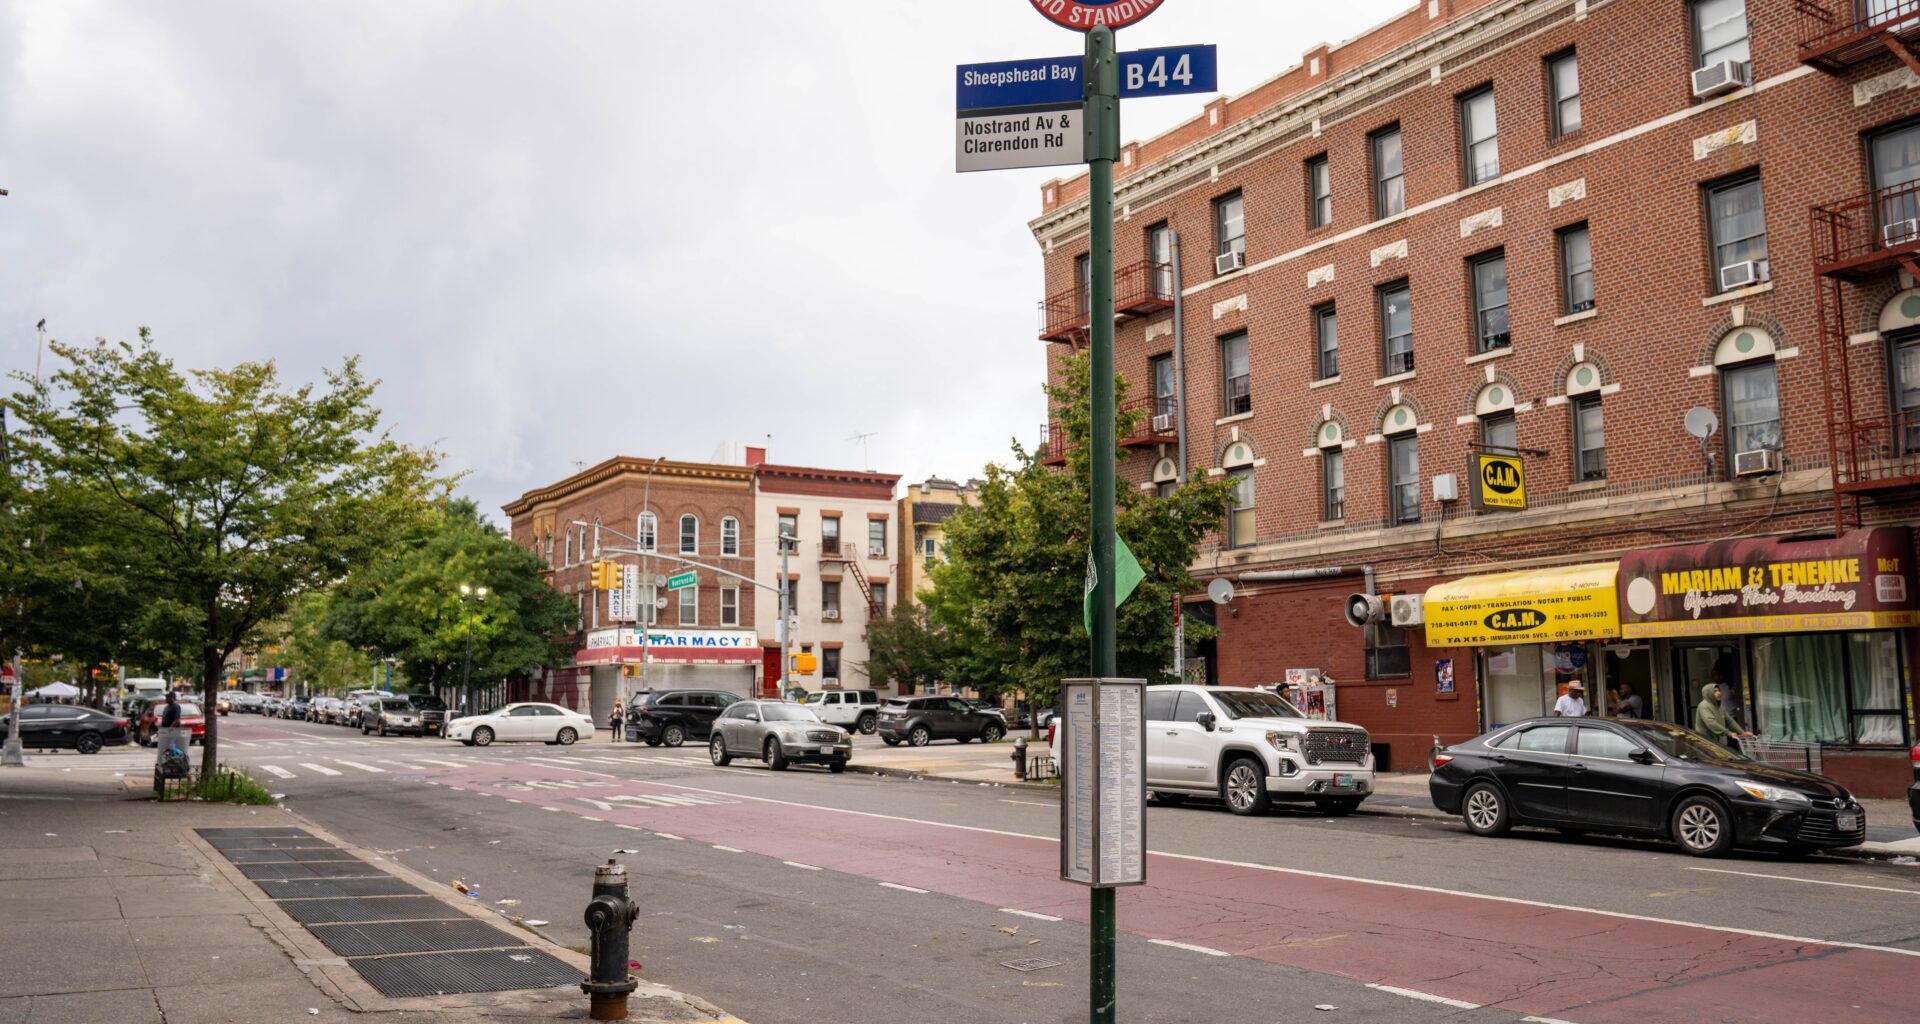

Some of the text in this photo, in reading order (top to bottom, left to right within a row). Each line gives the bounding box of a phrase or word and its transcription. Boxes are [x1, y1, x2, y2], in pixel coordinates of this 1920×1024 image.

[964, 64, 1077, 87] Sheepshead Bay
[1126, 54, 1193, 90] B44
[964, 114, 1070, 135] Nostrand Av &
[964, 133, 1063, 154] Clarendon Rd
[1486, 464, 1518, 488] C.A.M.
[1661, 558, 1861, 595] MARIAM & TENENKE
[1487, 600, 1532, 609] TRANSLATION
[1537, 597, 1564, 605] NOTARY
[1567, 594, 1592, 602] PUBLIC
[1683, 588, 1738, 620] African
[1740, 583, 1780, 607] Hair
[1780, 581, 1857, 610] Braiding
[1491, 612, 1539, 628] C.A.M.
[639, 636, 740, 646] PHARMACY
[1447, 636, 1486, 644] TAXES
[1490, 631, 1530, 641] IMMIGRATION
